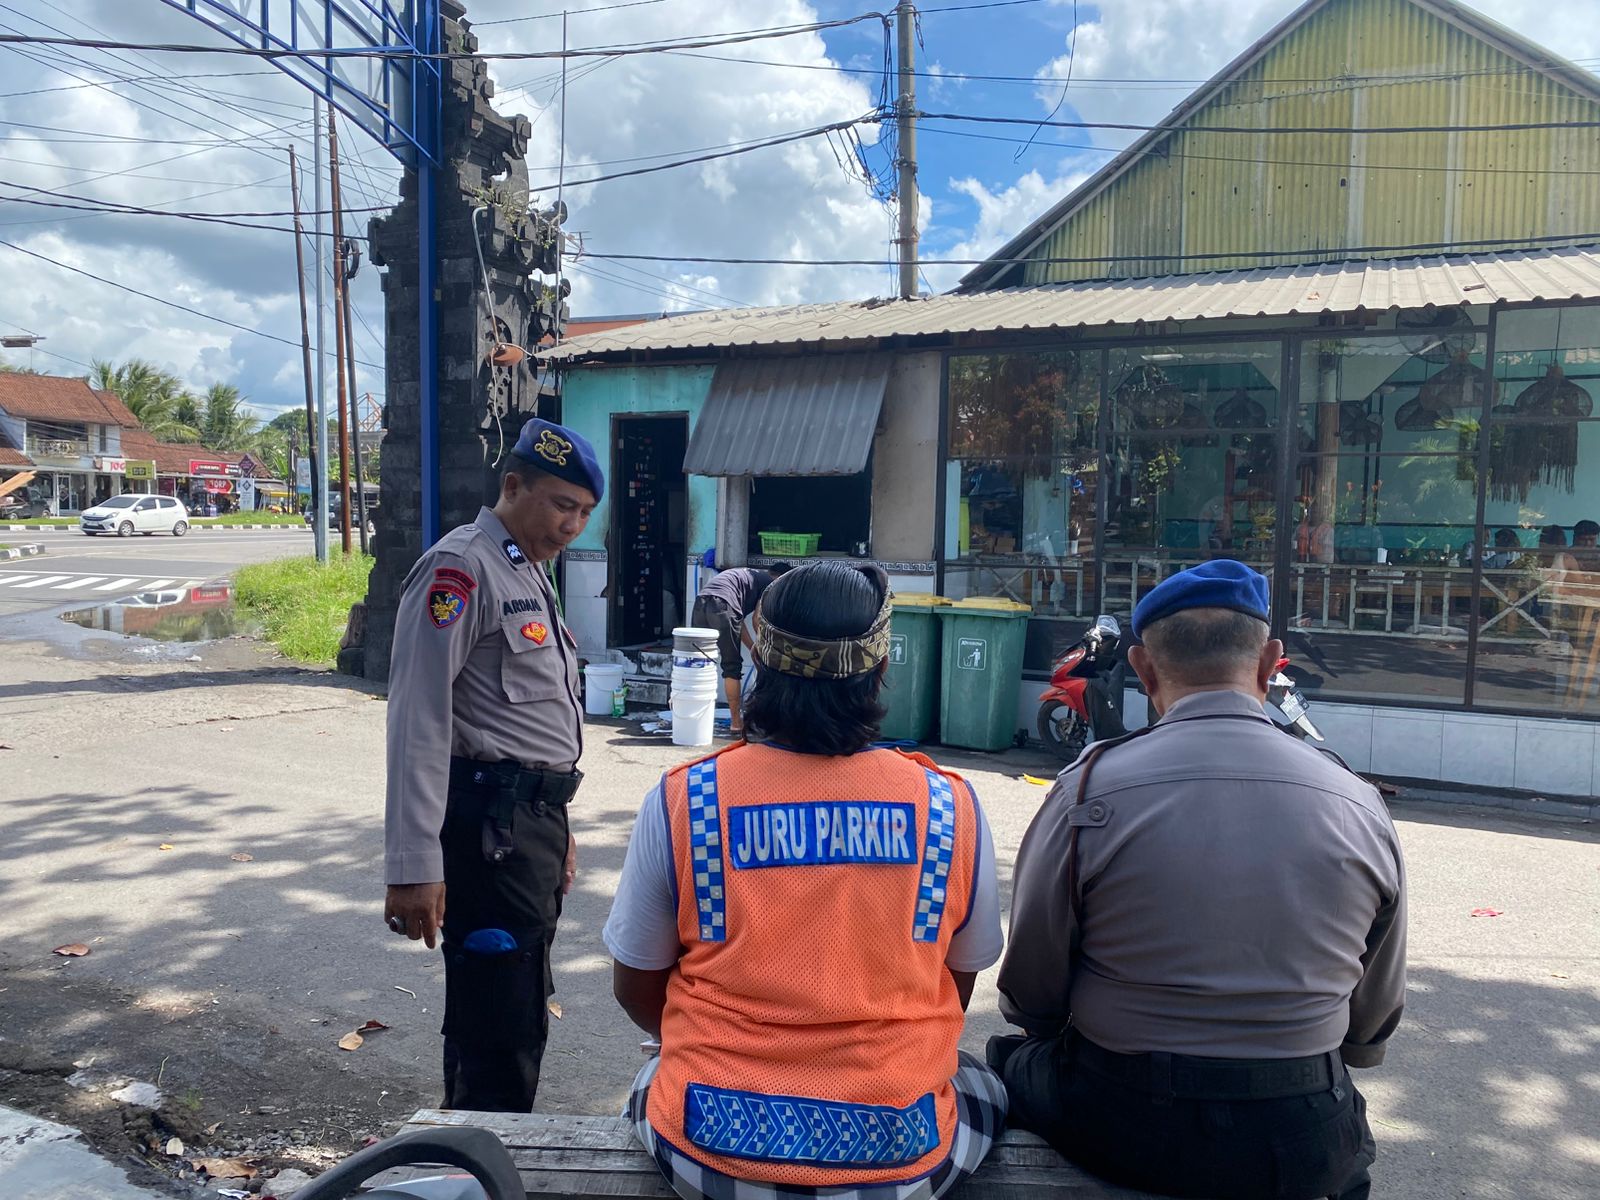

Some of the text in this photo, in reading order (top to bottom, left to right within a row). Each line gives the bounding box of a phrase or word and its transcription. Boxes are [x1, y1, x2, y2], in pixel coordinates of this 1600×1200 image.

[503, 598, 543, 616] ARDAN
[737, 806, 910, 863] JURU PARKIR
